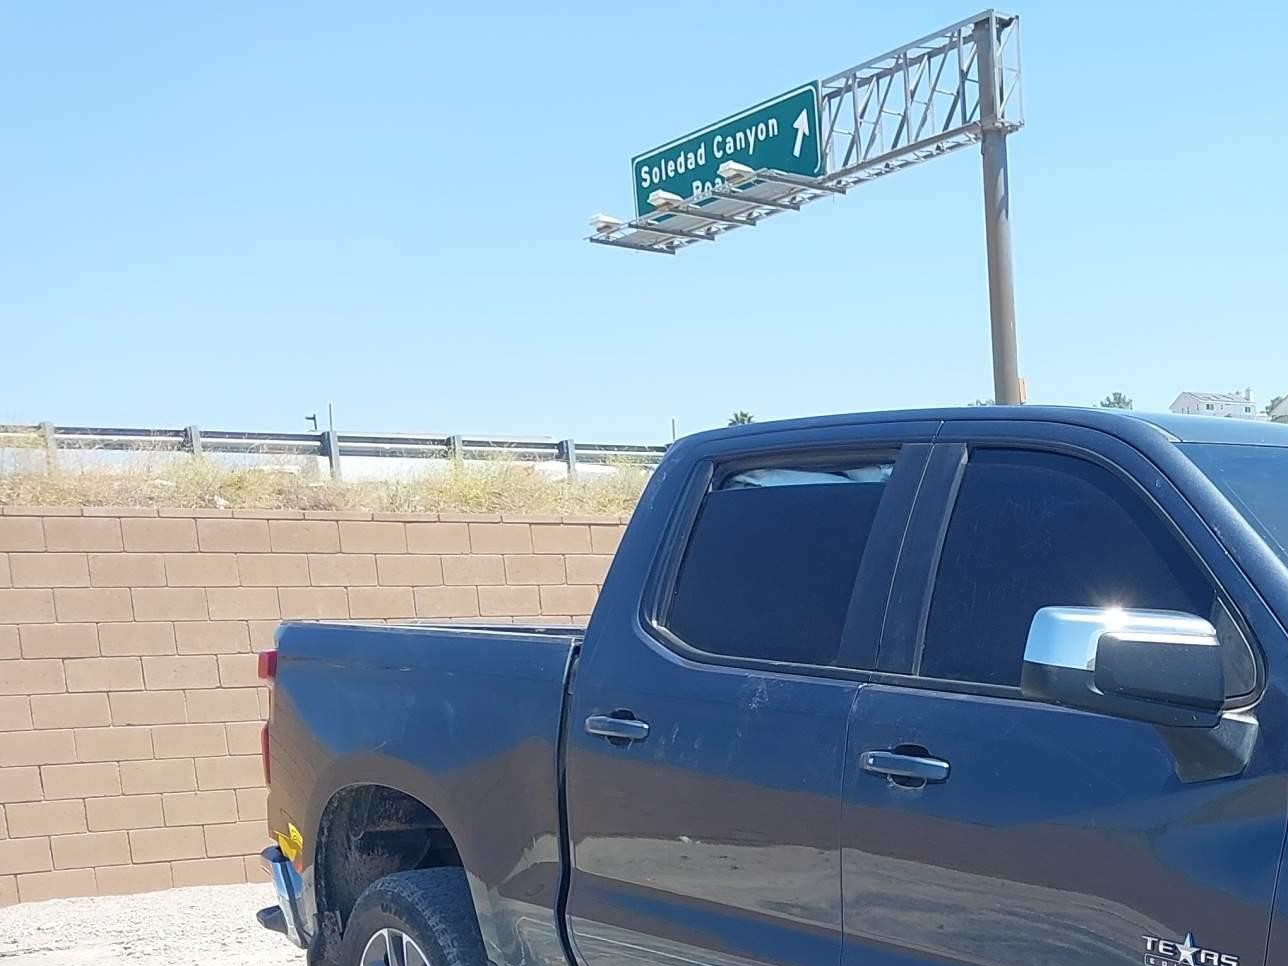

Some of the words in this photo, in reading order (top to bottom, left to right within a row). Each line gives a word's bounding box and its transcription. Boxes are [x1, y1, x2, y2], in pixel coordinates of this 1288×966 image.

[641, 141, 706, 188] Soledad
[713, 118, 778, 158] Canyon
[692, 176, 726, 200] Roa
